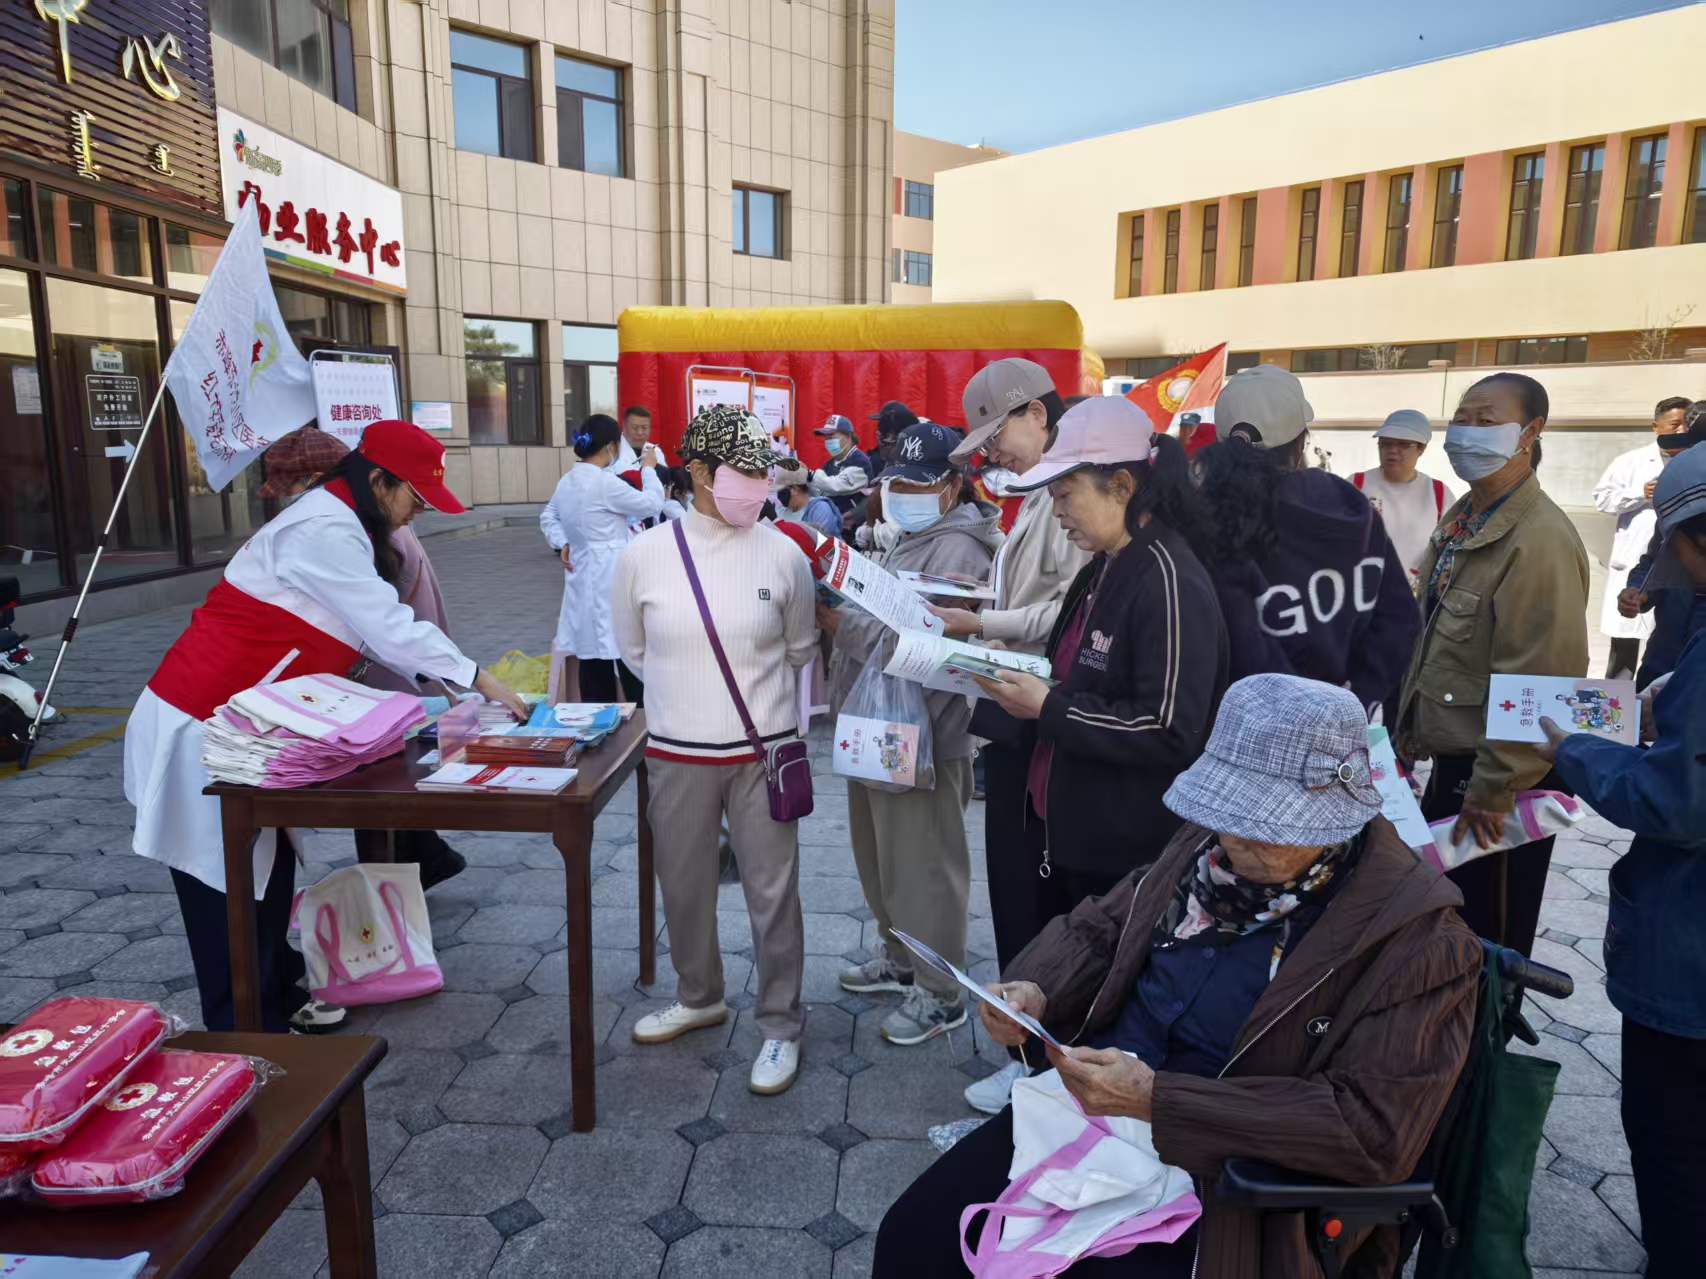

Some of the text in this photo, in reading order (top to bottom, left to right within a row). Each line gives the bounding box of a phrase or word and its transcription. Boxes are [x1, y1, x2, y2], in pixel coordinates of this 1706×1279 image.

[330, 404, 383, 422] 健康咨询处
[1520, 688, 1534, 726] 急救手册
